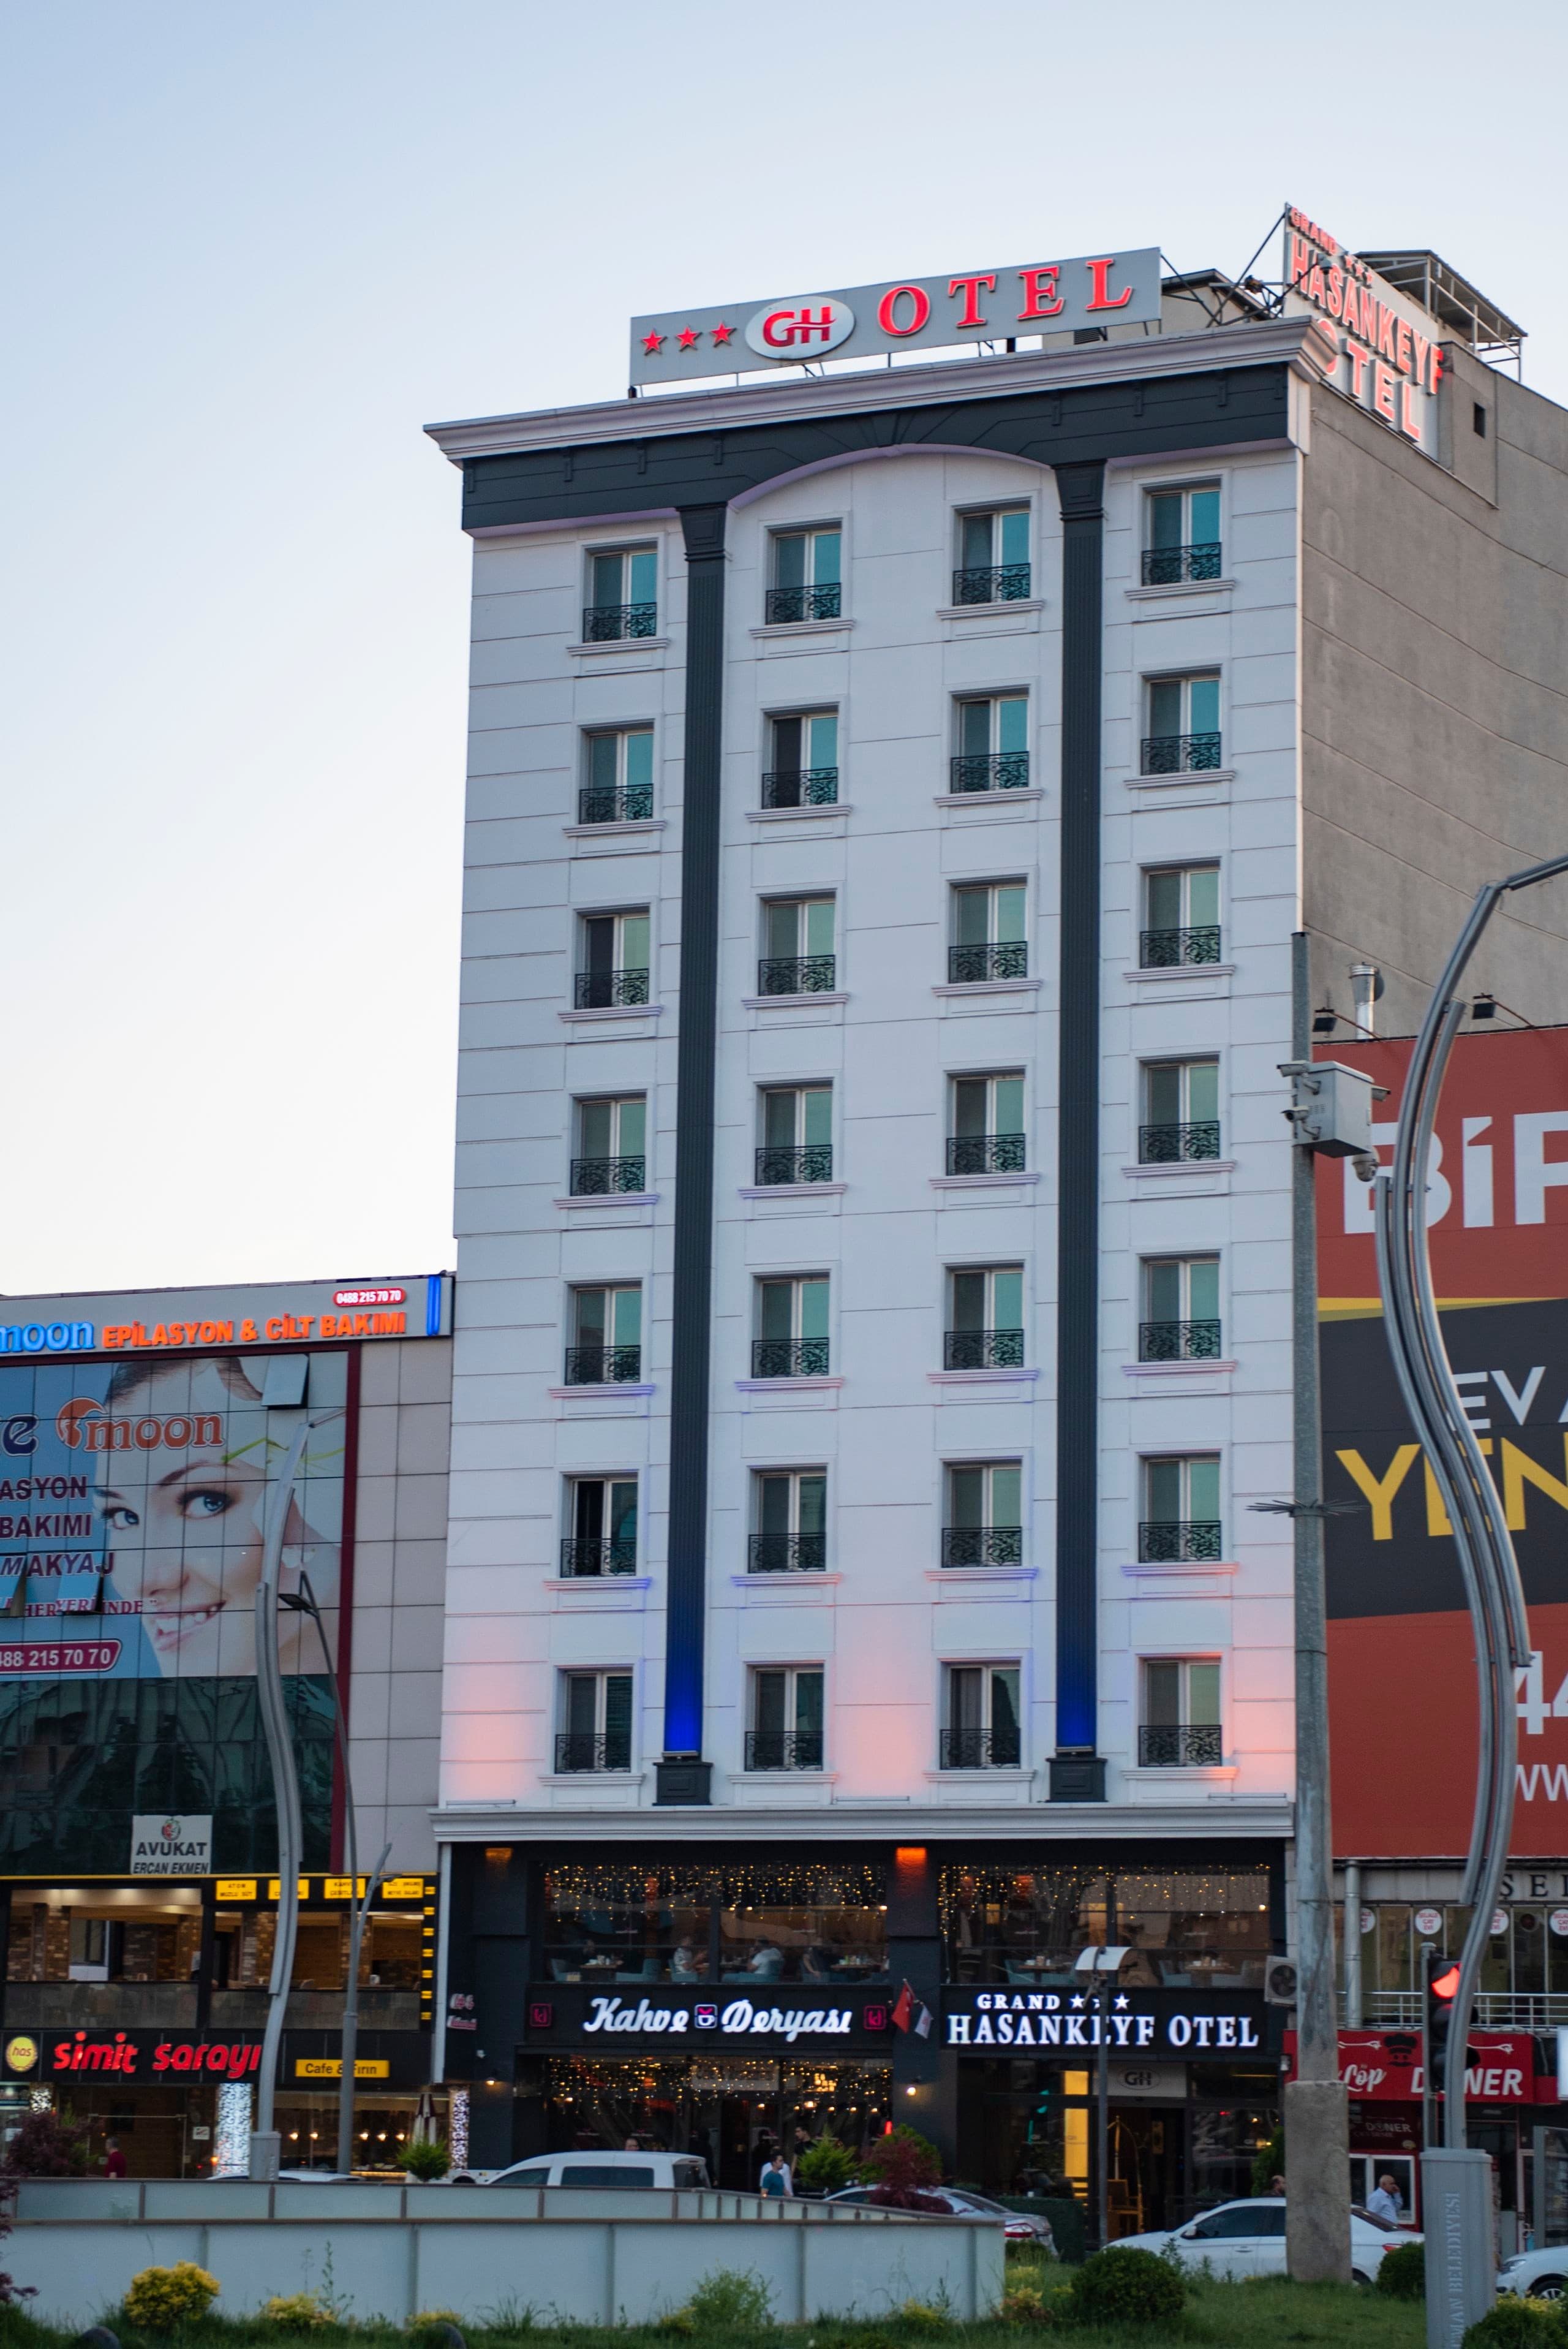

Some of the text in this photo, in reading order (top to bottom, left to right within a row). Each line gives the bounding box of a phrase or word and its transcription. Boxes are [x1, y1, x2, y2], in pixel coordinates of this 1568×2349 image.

[1289, 206, 1338, 256] GRAND
[763, 258, 1134, 348] GH OTEL
[1290, 230, 1444, 395] HASANKEYF
[359, 1291, 376, 1303] 215
[377, 1290, 389, 1302] 70
[390, 1290, 402, 1301] 70
[102, 1321, 233, 1348] EPİLASYON
[240, 1318, 258, 1342] &
[265, 1313, 314, 1340] CİLT
[320, 1312, 405, 1337] BAKIMI
[84, 1413, 224, 1453] moon
[0, 1514, 92, 1539] BAKIMI
[1, 1551, 115, 1578] MAKYAJ
[0, 1648, 111, 1666] 88 215 70 70
[136, 1842, 208, 1856] AVUKAT
[133, 1863, 209, 1874] ERCAN EKMEN
[977, 1994, 1061, 2010] GRAND
[583, 1997, 690, 2033] Kahve
[721, 1999, 853, 2043] Deryası
[947, 2013, 1259, 2047] HASANKEYF OTEL
[12, 2030, 263, 2079] has simit sarayı
[305, 2063, 333, 2075] Cafe
[1411, 2067, 1523, 2096] DNER
